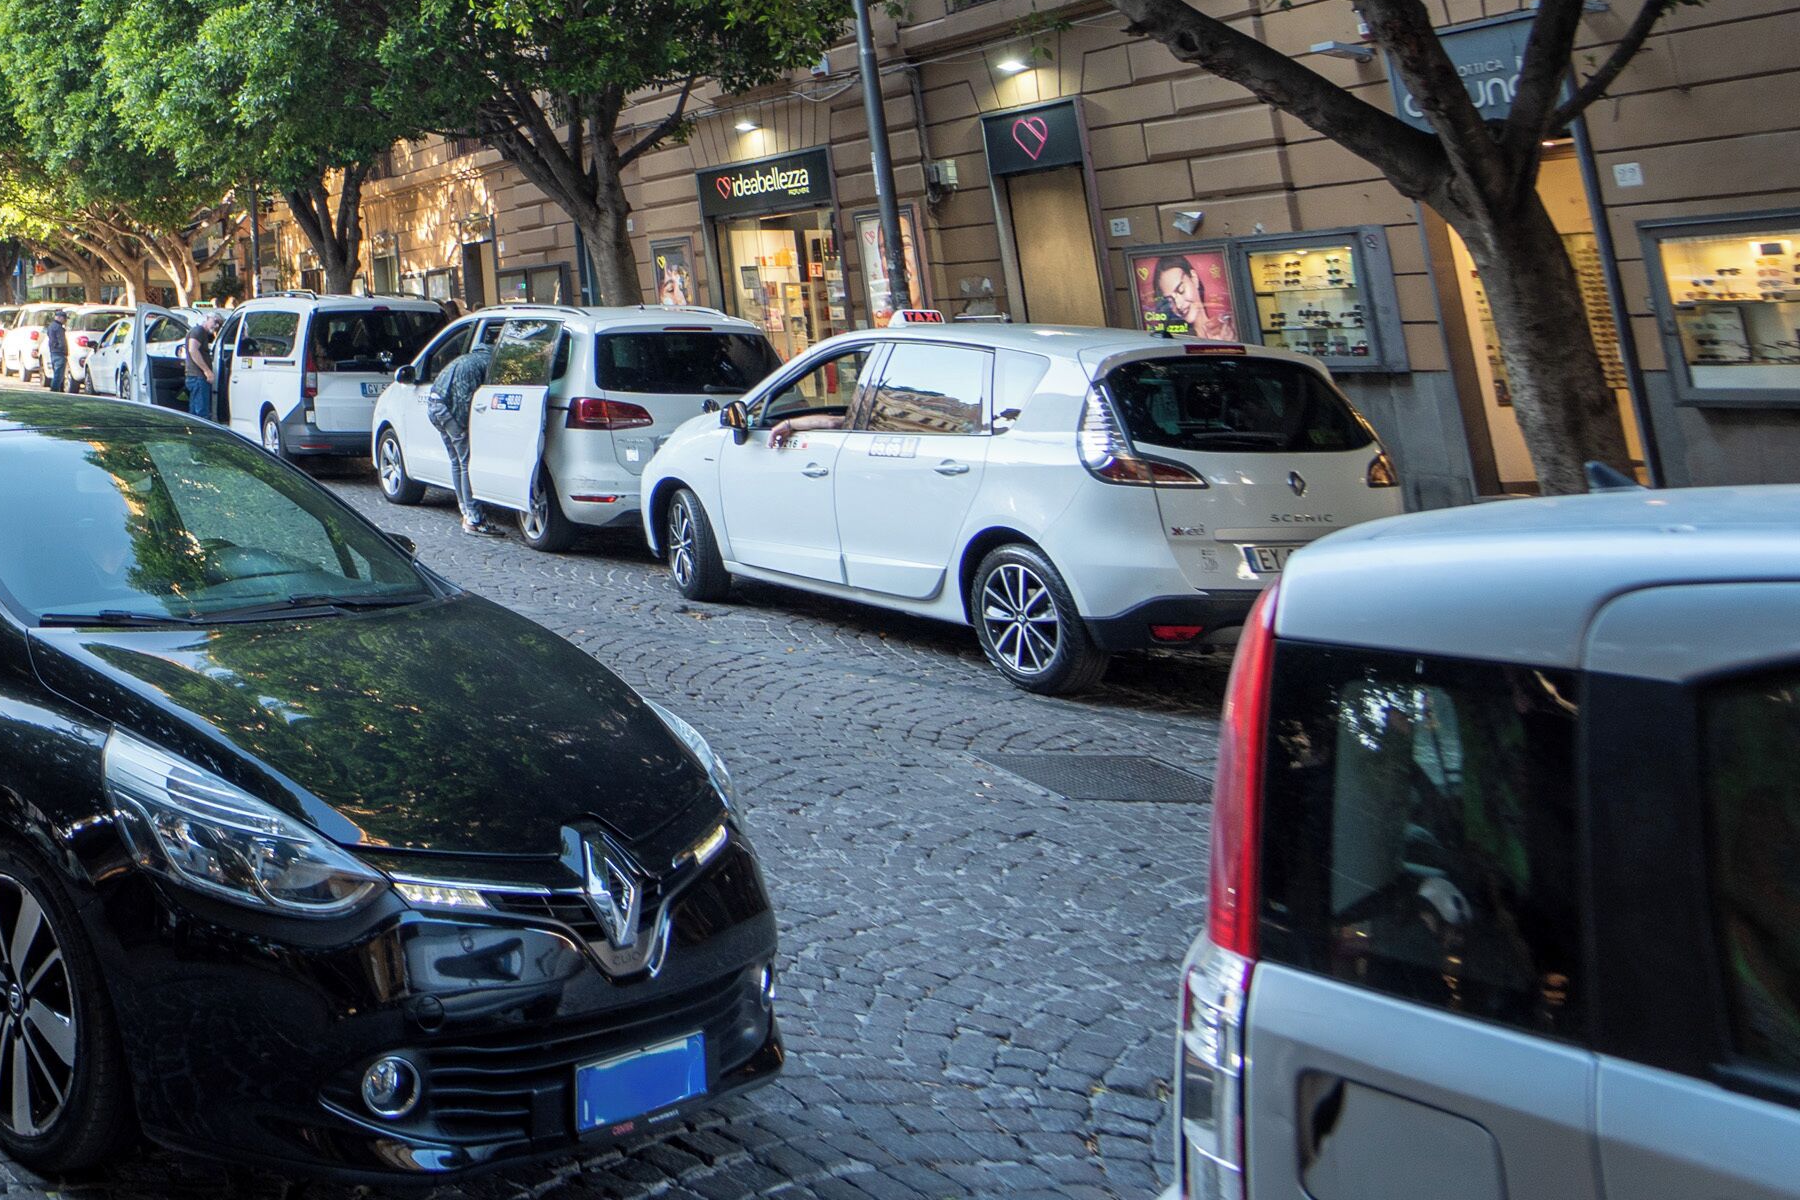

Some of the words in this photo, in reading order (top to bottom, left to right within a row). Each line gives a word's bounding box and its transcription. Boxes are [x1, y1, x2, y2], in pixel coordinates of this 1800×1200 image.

[731, 166, 809, 197] ideabellezza
[904, 311, 941, 322] TAXI
[1144, 311, 1167, 321] Ciao
[367, 384, 379, 395] GV
[1270, 513, 1335, 523] SCENIC
